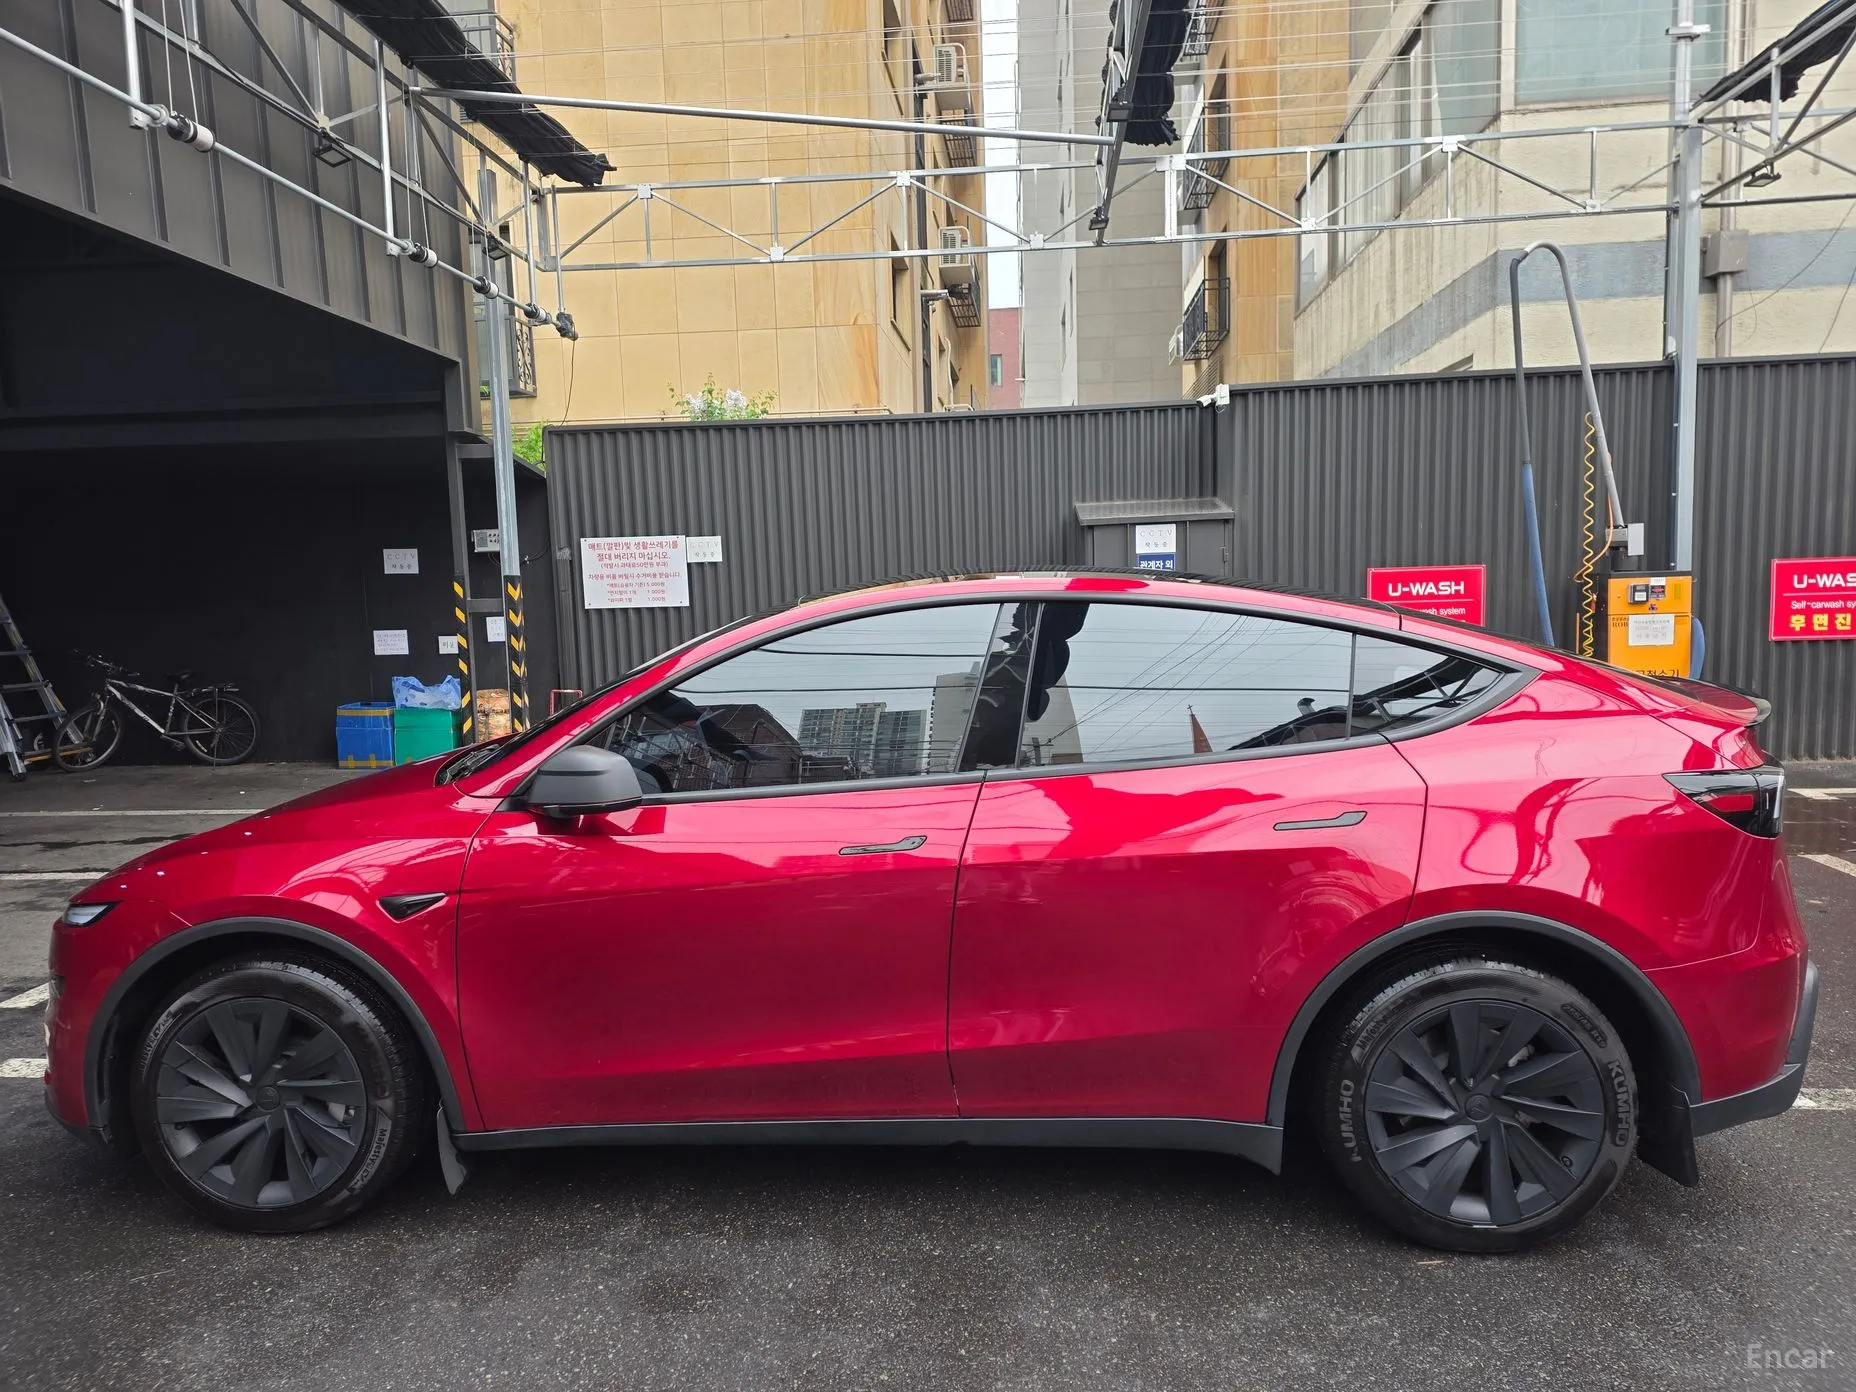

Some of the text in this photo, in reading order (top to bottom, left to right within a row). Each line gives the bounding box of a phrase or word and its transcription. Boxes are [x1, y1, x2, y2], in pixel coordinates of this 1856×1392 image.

[634, 540, 679, 550] 생활쓰레기를
[597, 551, 671, 561] 절대 버리지 마십시오.
[1140, 559, 1173, 570] 관계자 외
[1388, 581, 1465, 597] U-WASH
[1791, 600, 1844, 609] Self-carwash
[1440, 607, 1466, 616] system
[1607, 1060, 1630, 1147] KUMHO
